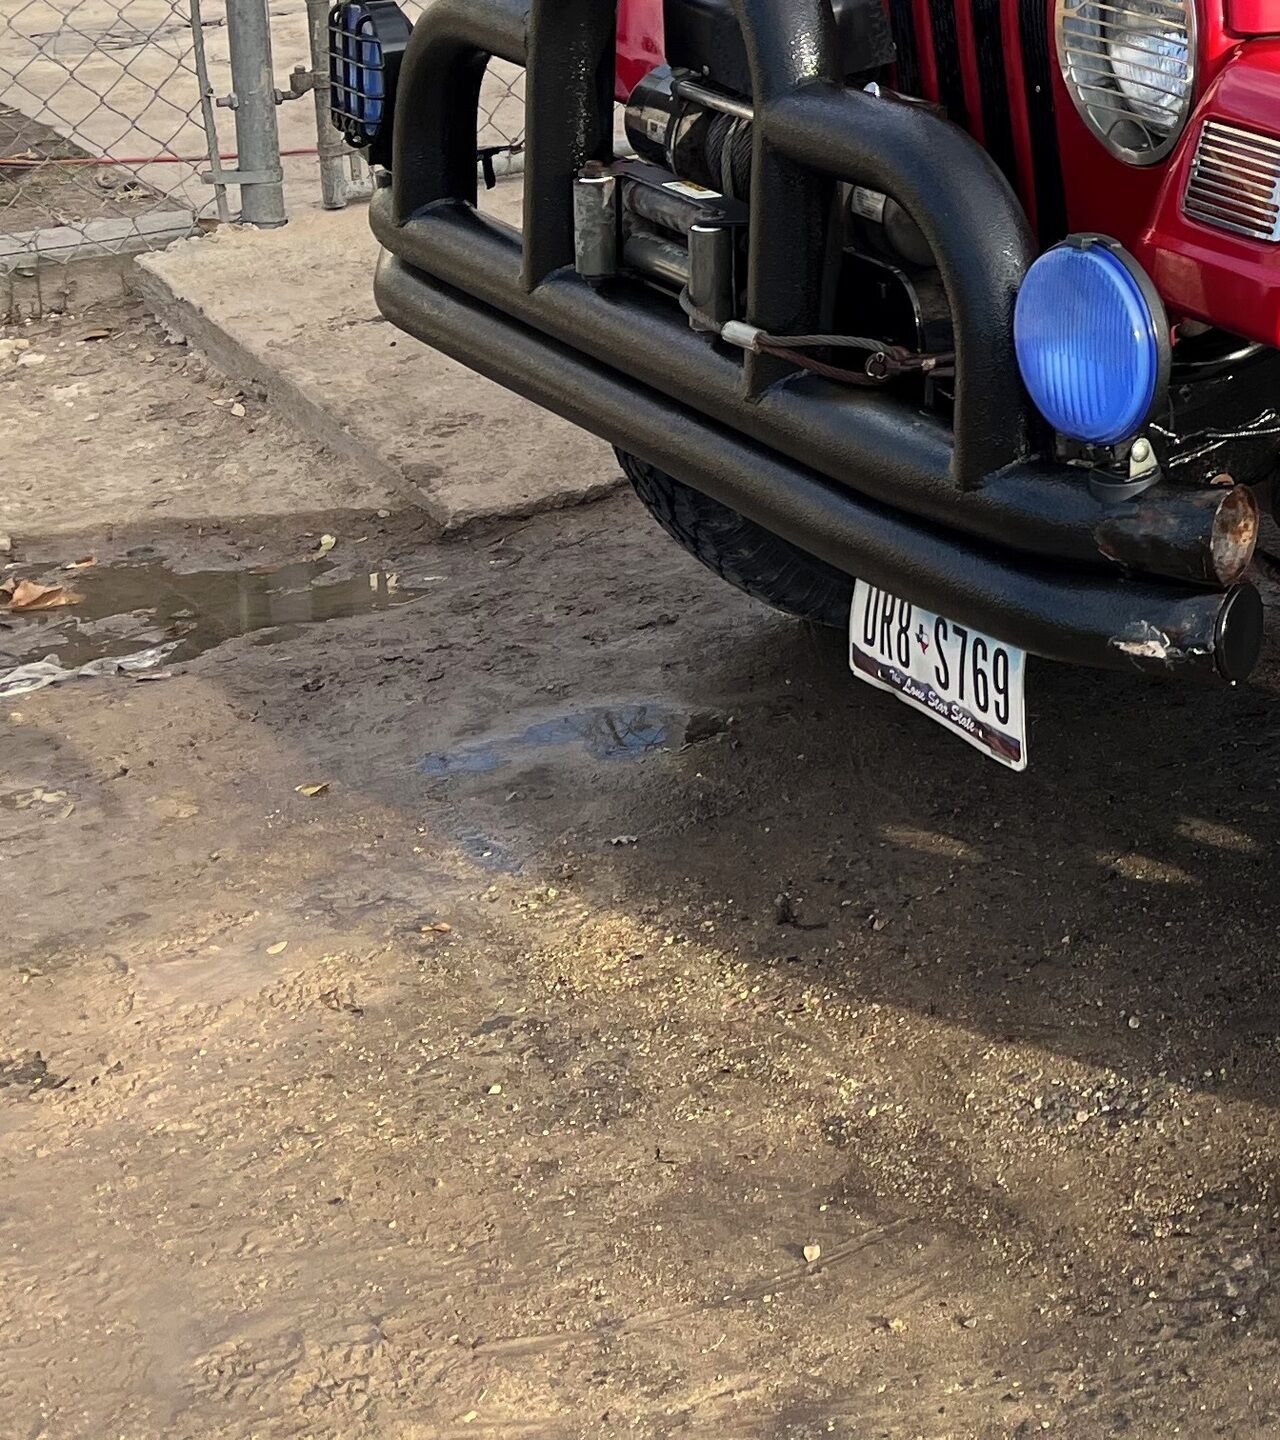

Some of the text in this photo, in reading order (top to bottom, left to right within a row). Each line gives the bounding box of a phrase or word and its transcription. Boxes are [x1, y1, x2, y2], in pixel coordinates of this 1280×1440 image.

[902, 677, 926, 702] Lone
[927, 691, 950, 716] Star
[950, 704, 977, 733] State
[933, 615, 1010, 726] S769
